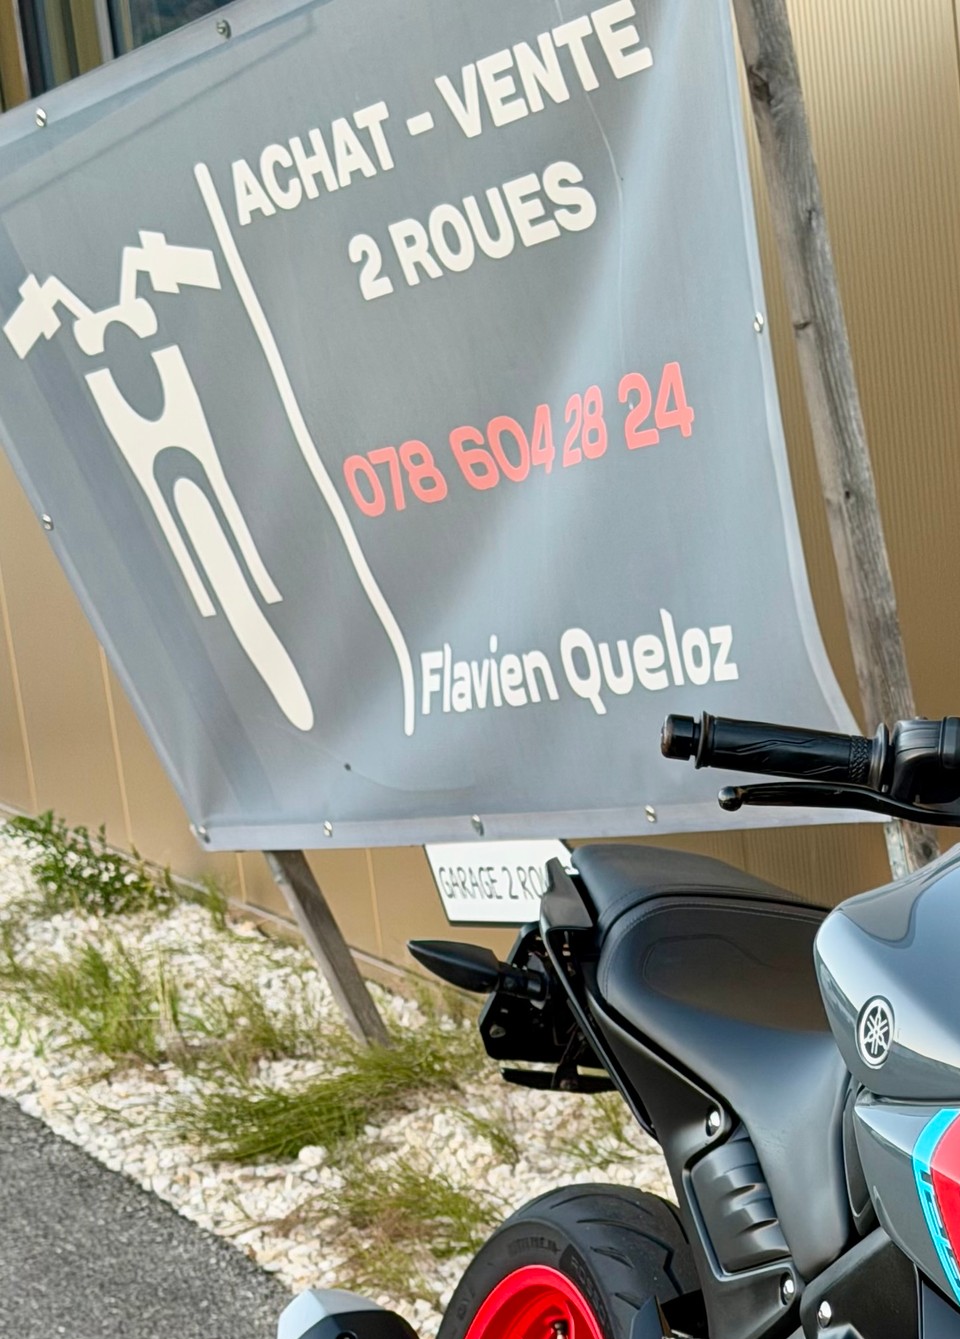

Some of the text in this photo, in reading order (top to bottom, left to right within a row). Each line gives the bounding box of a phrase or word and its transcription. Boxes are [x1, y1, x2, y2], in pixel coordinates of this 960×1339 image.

[232, 0, 654, 226] ACHAT - VENTE
[348, 161, 598, 301] 2 ROUES
[343, 362, 695, 517] 078 604 28 24
[421, 609, 739, 716] Flavien Queloz
[438, 866, 503, 899] GARAGE
[502, 866, 519, 899] 2
